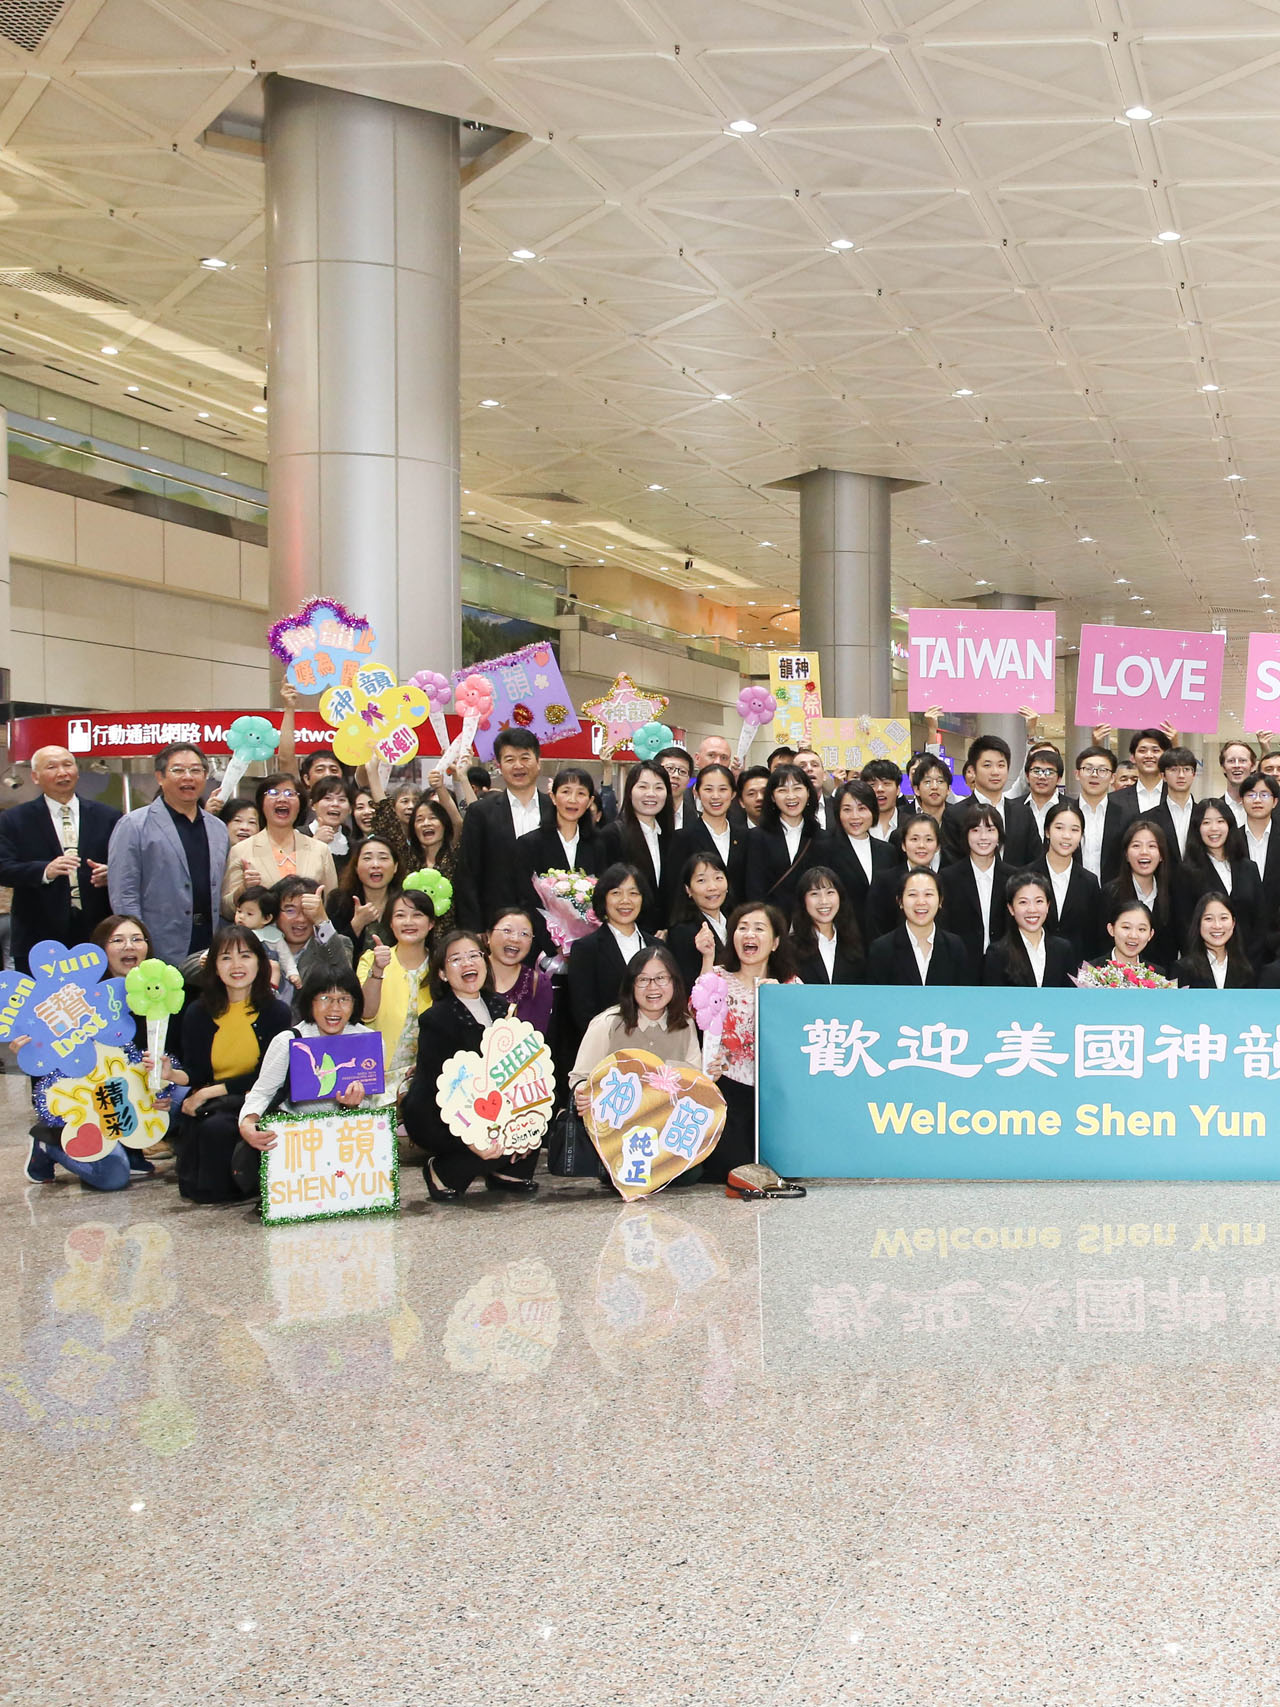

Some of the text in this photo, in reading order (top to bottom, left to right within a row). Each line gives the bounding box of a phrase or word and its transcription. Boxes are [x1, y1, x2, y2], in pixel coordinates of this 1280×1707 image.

[911, 636, 1053, 681] TAIWAN
[1092, 652, 1206, 701] LOVE
[330, 671, 394, 722] 神韻
[92, 723, 201, 746] 行動通訊網路
[40, 951, 100, 977] yun
[52, 1012, 108, 1058] best
[489, 1033, 541, 1087] SHEN
[95, 1081, 134, 1136] 精彩
[504, 1078, 549, 1110] YUN
[509, 1117, 537, 1132] Love
[867, 1102, 1062, 1136] Welcome
[1075, 1103, 1177, 1137] Shen
[1190, 1104, 1267, 1137] Yun
[284, 1119, 375, 1173] 神韻
[625, 1132, 653, 1183] 純正
[271, 1170, 394, 1205] SHEN YUN
